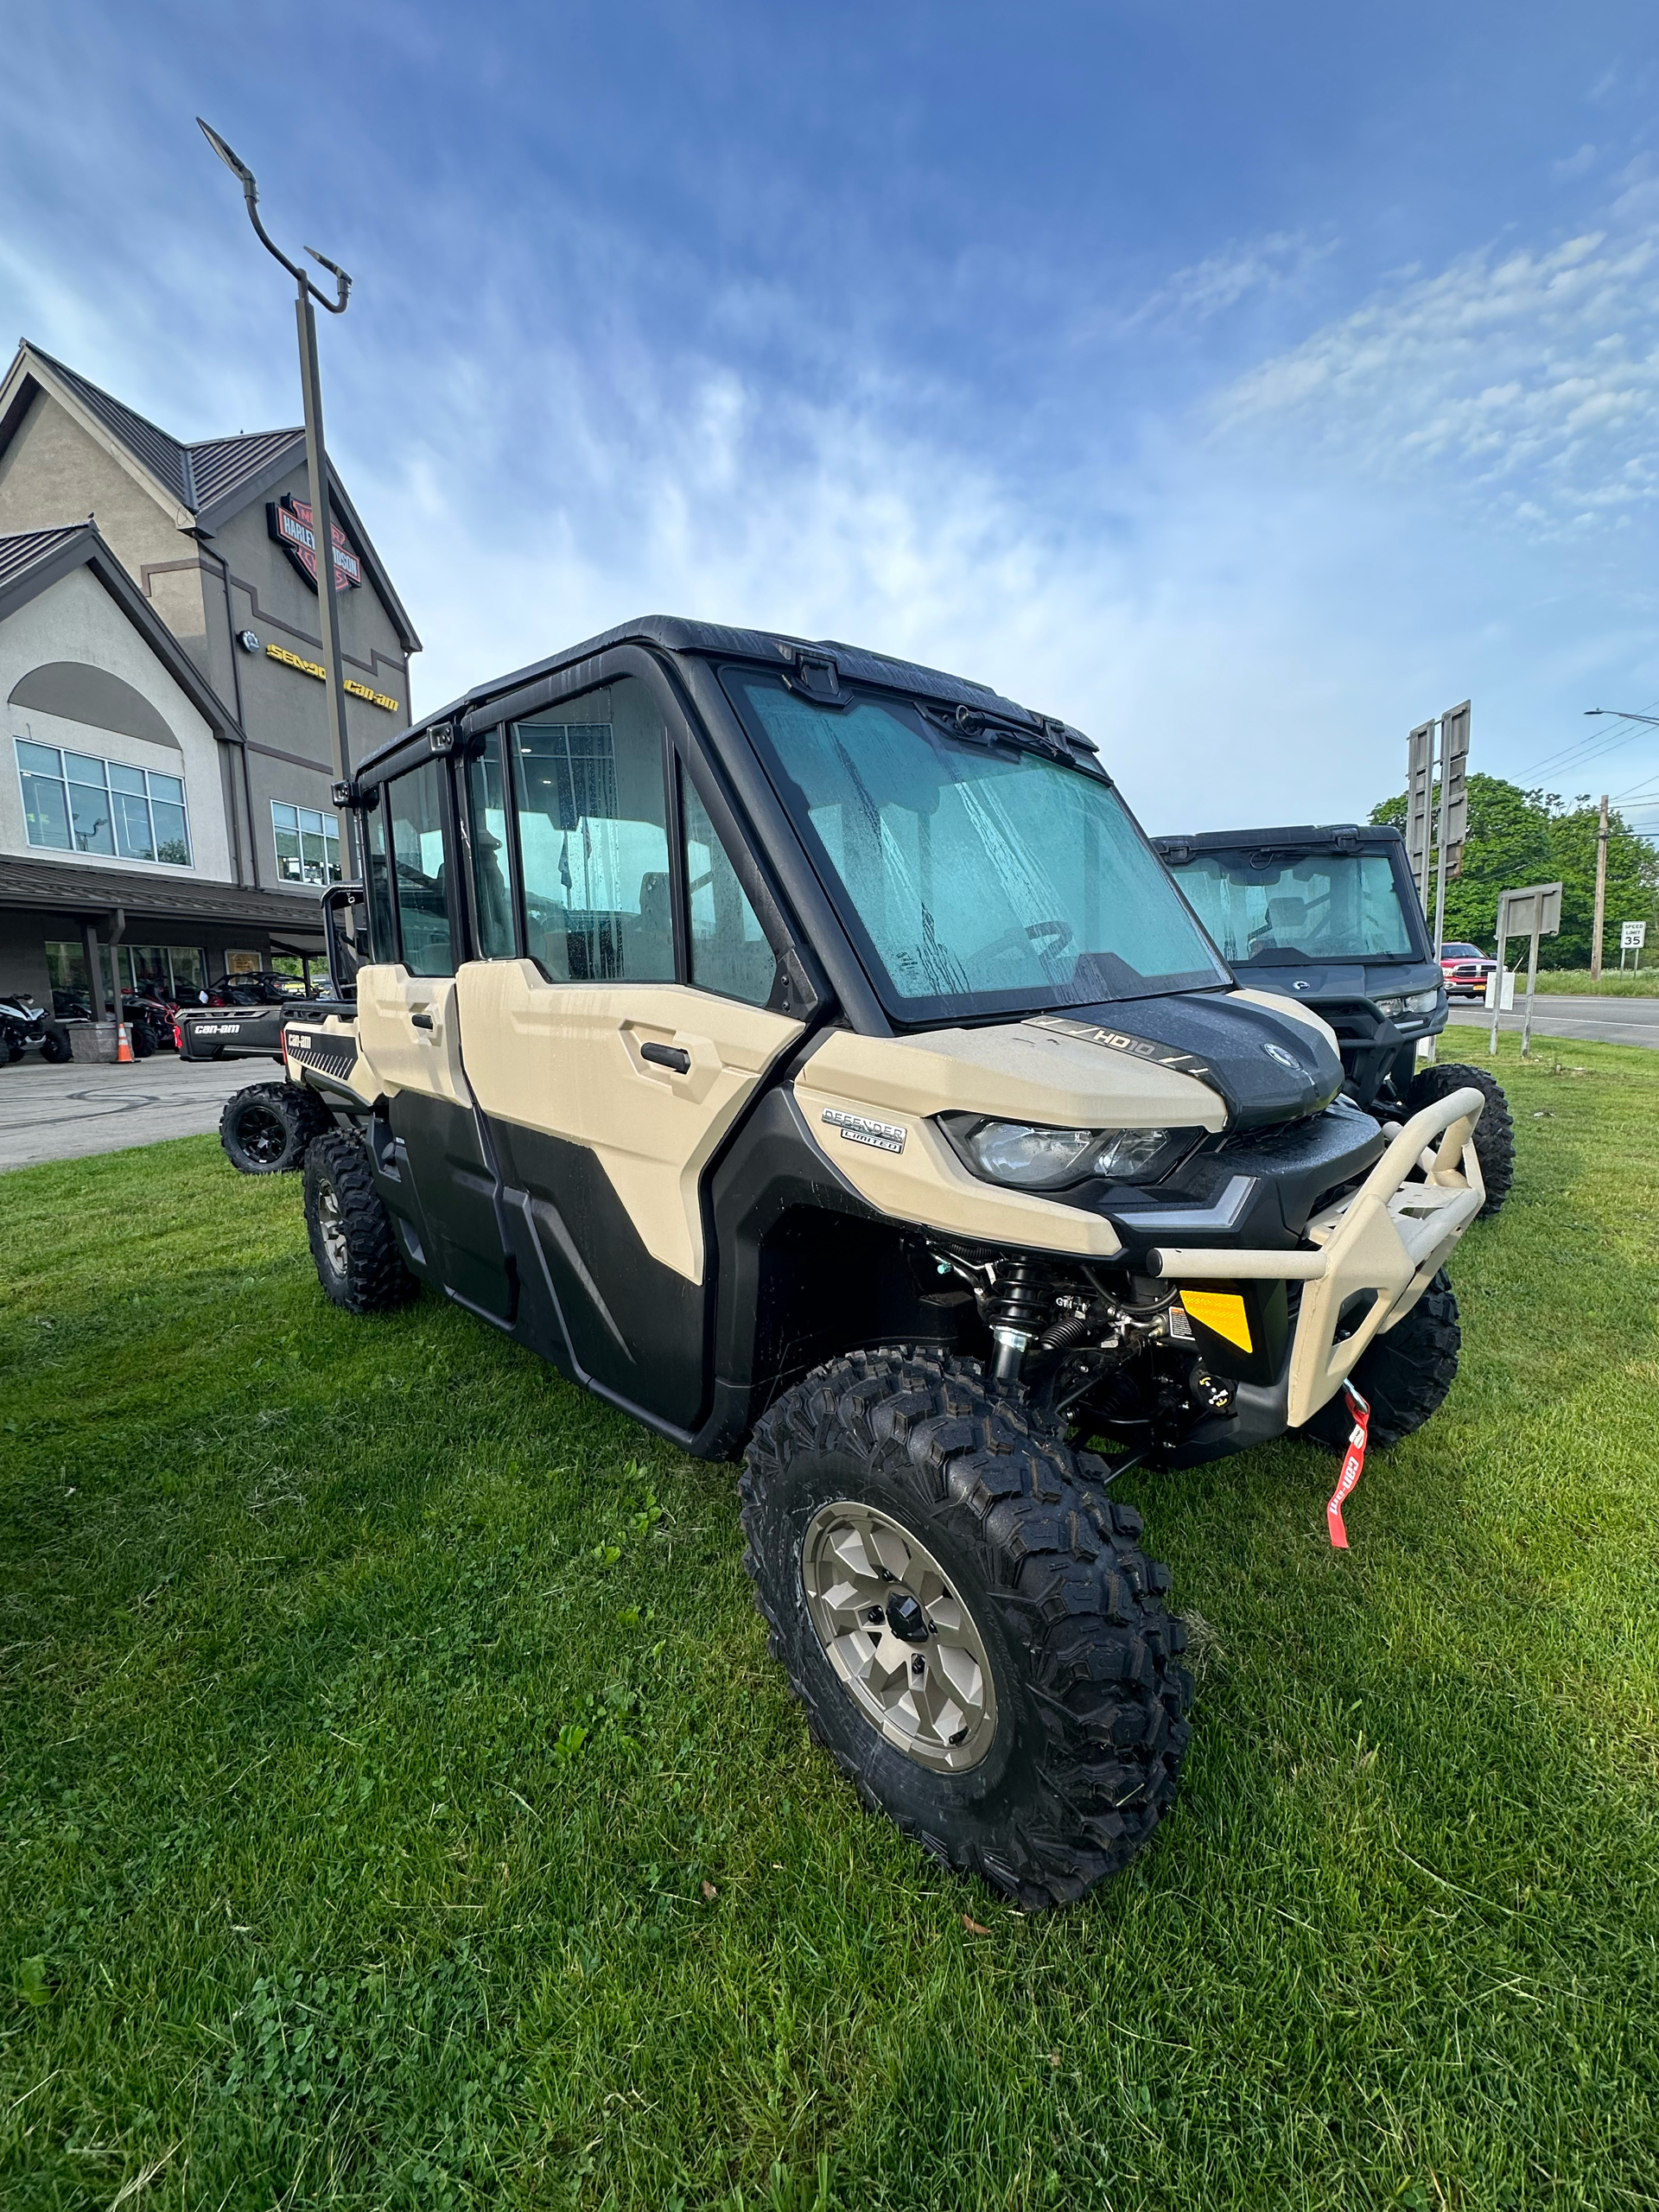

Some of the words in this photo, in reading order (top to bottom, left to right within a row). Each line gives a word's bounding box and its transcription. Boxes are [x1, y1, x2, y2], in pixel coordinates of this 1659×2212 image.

[1624, 936, 1641, 945] 35
[194, 1024, 240, 1034] can-am
[288, 1033, 311, 1049] can-am
[1093, 1030, 1155, 1056] HD10
[823, 1109, 904, 1143] DEFENDER
[844, 1131, 898, 1150] LIMITED
[1329, 1456, 1360, 1516] can-am
